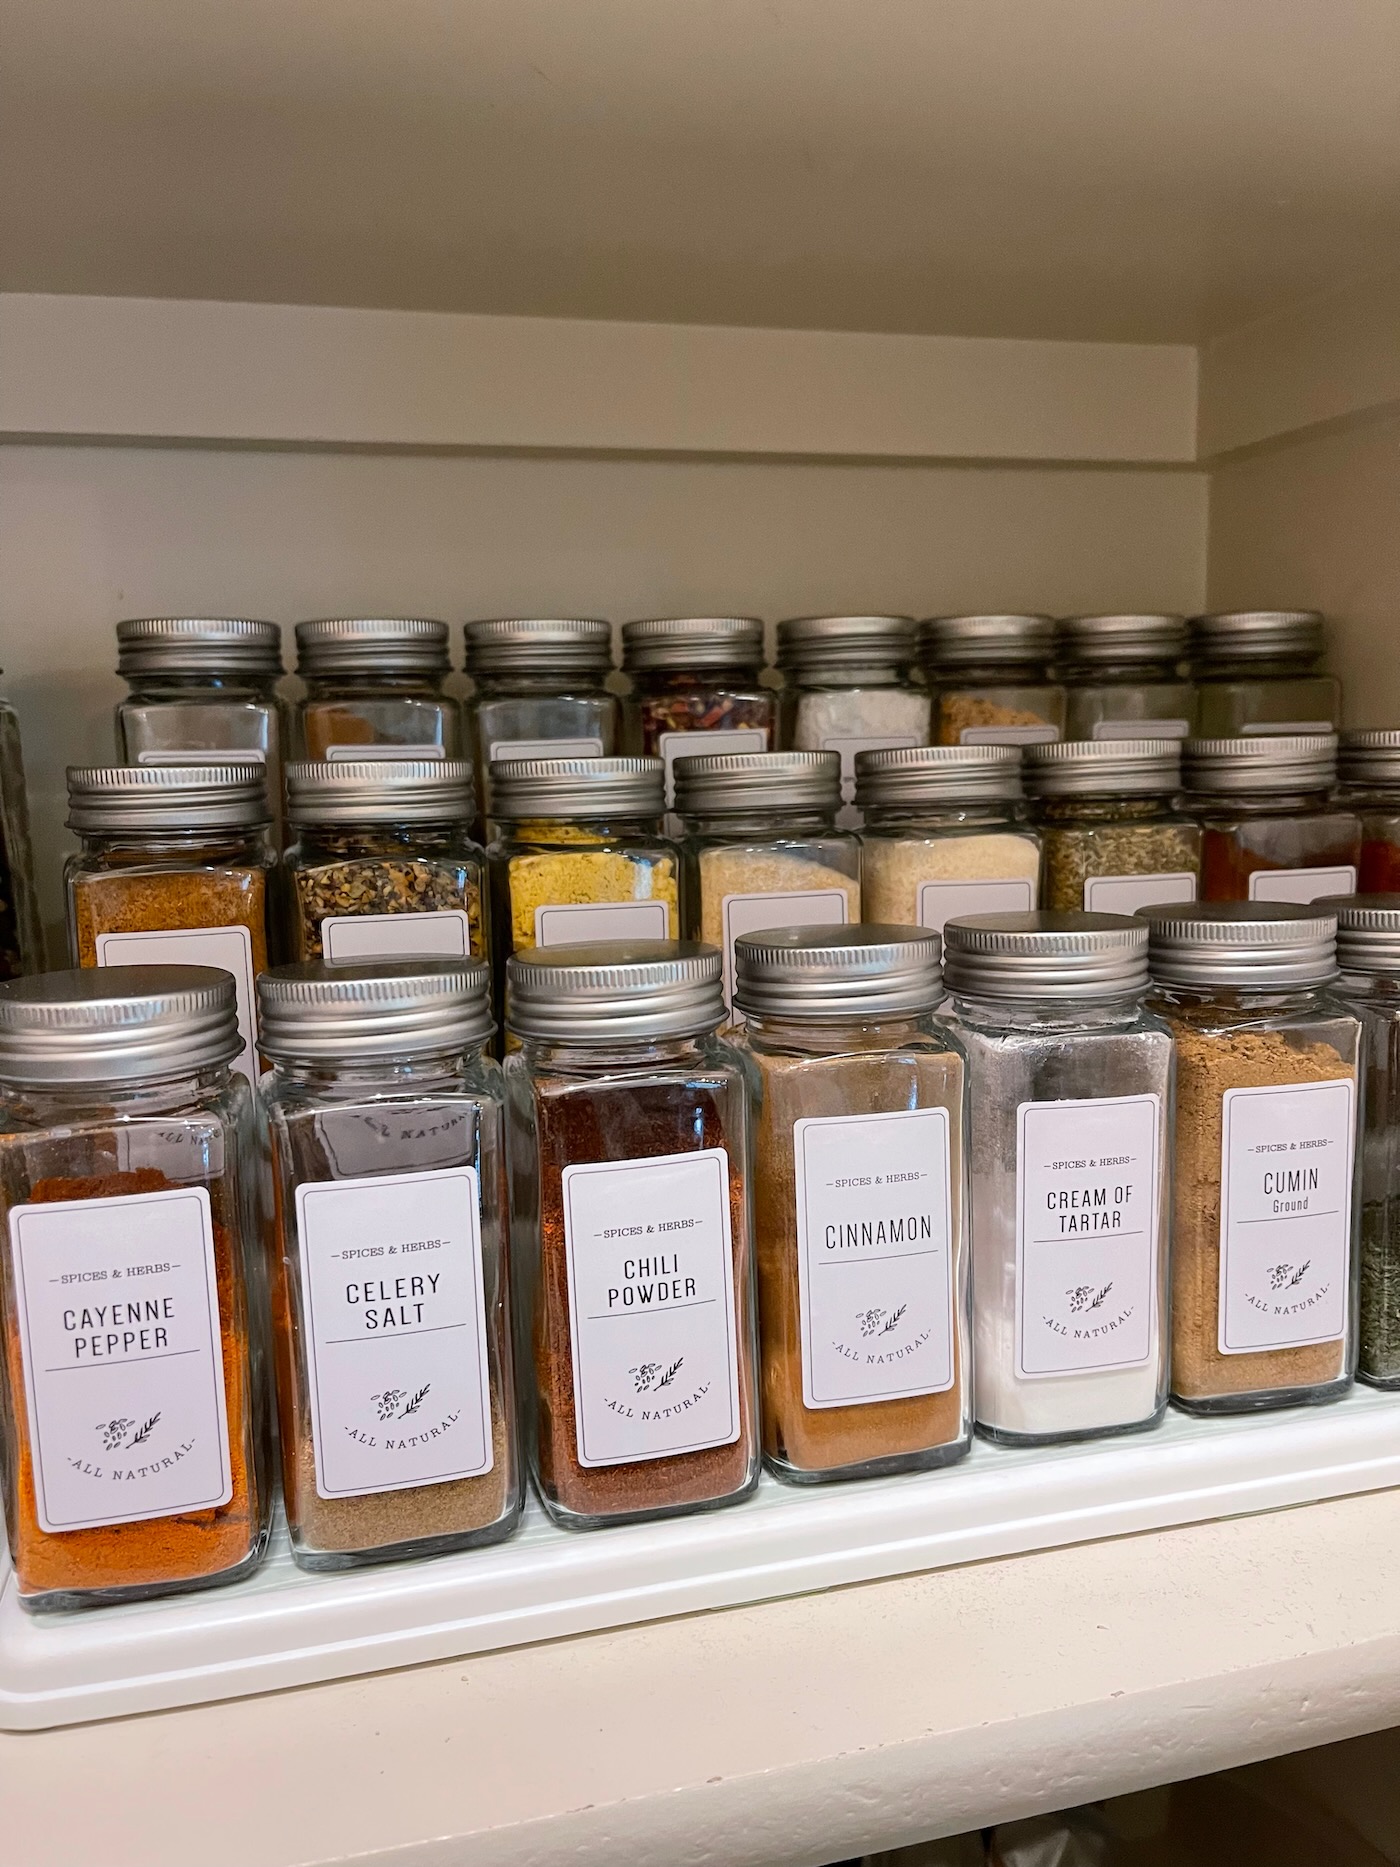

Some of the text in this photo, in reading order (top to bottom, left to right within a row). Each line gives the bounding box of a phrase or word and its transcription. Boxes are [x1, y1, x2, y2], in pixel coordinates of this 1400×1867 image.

[1289, 1142, 1298, 1151] &
[1088, 1159, 1098, 1168] &
[874, 1175, 884, 1185] &
[1263, 1167, 1319, 1195] CUMIN
[1046, 1184, 1134, 1211] CREAM OF
[1272, 1197, 1309, 1214] Ground
[645, 1224, 656, 1234] &
[825, 1214, 932, 1250] CINNAMON
[1058, 1209, 1122, 1234] TARTAR
[387, 1245, 398, 1255] &
[111, 1268, 123, 1279] &
[623, 1253, 679, 1280] CHILI
[345, 1272, 441, 1305] CELERY
[607, 1277, 696, 1309] POWDER
[63, 1296, 176, 1332] CAYENNE
[364, 1302, 425, 1330] SALT
[74, 1326, 168, 1359] PEPPER
